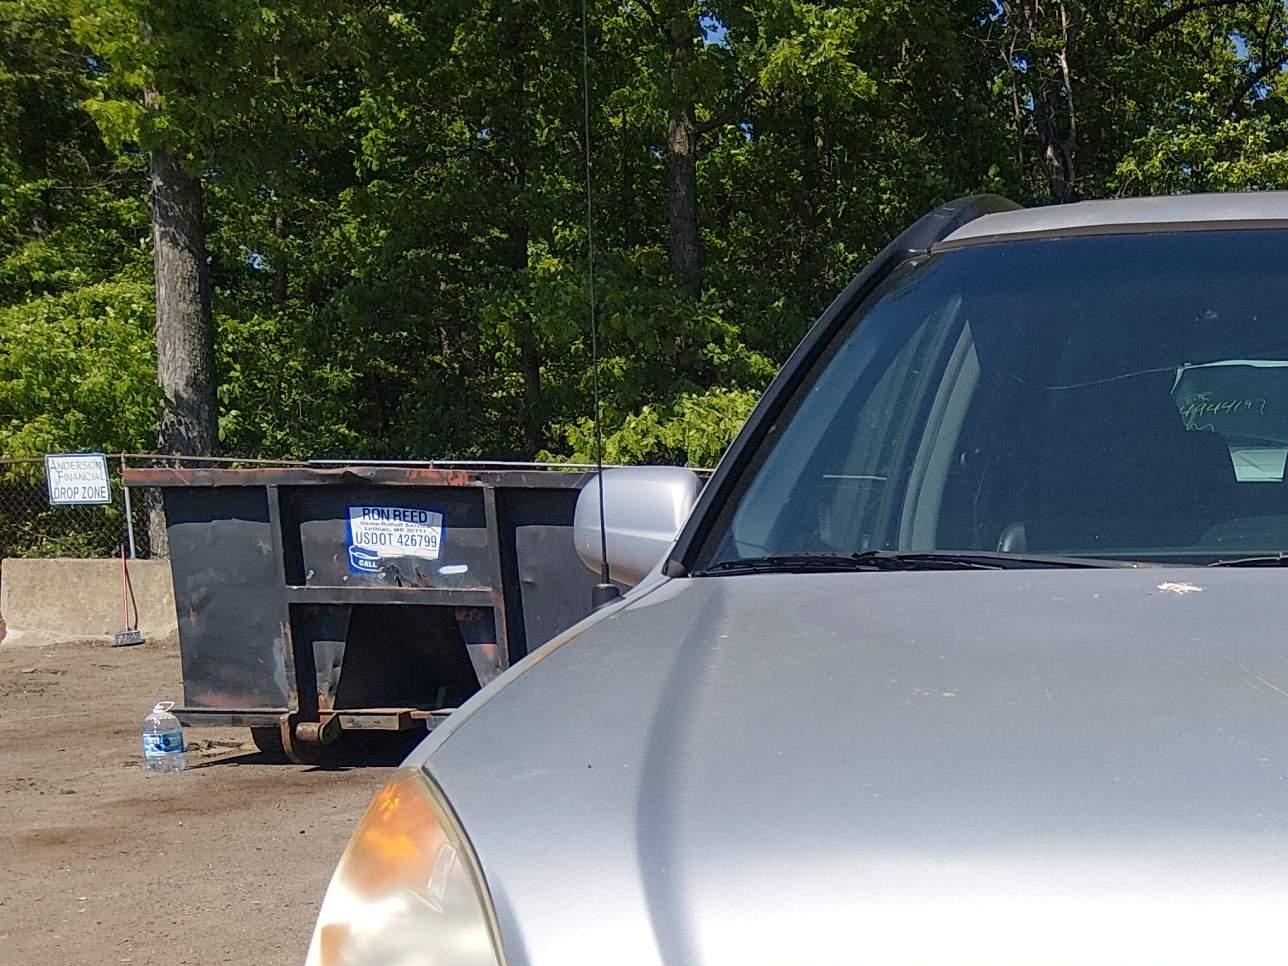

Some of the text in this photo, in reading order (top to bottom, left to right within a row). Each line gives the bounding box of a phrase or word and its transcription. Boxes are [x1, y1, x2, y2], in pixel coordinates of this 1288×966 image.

[50, 459, 103, 471] ANDERSON
[57, 471, 106, 483] FINANCIAL
[54, 486, 107, 500] DROP ZONE
[362, 507, 428, 524] RON REED
[355, 531, 437, 548] USDOT 426799
[358, 559, 378, 568] CALL
